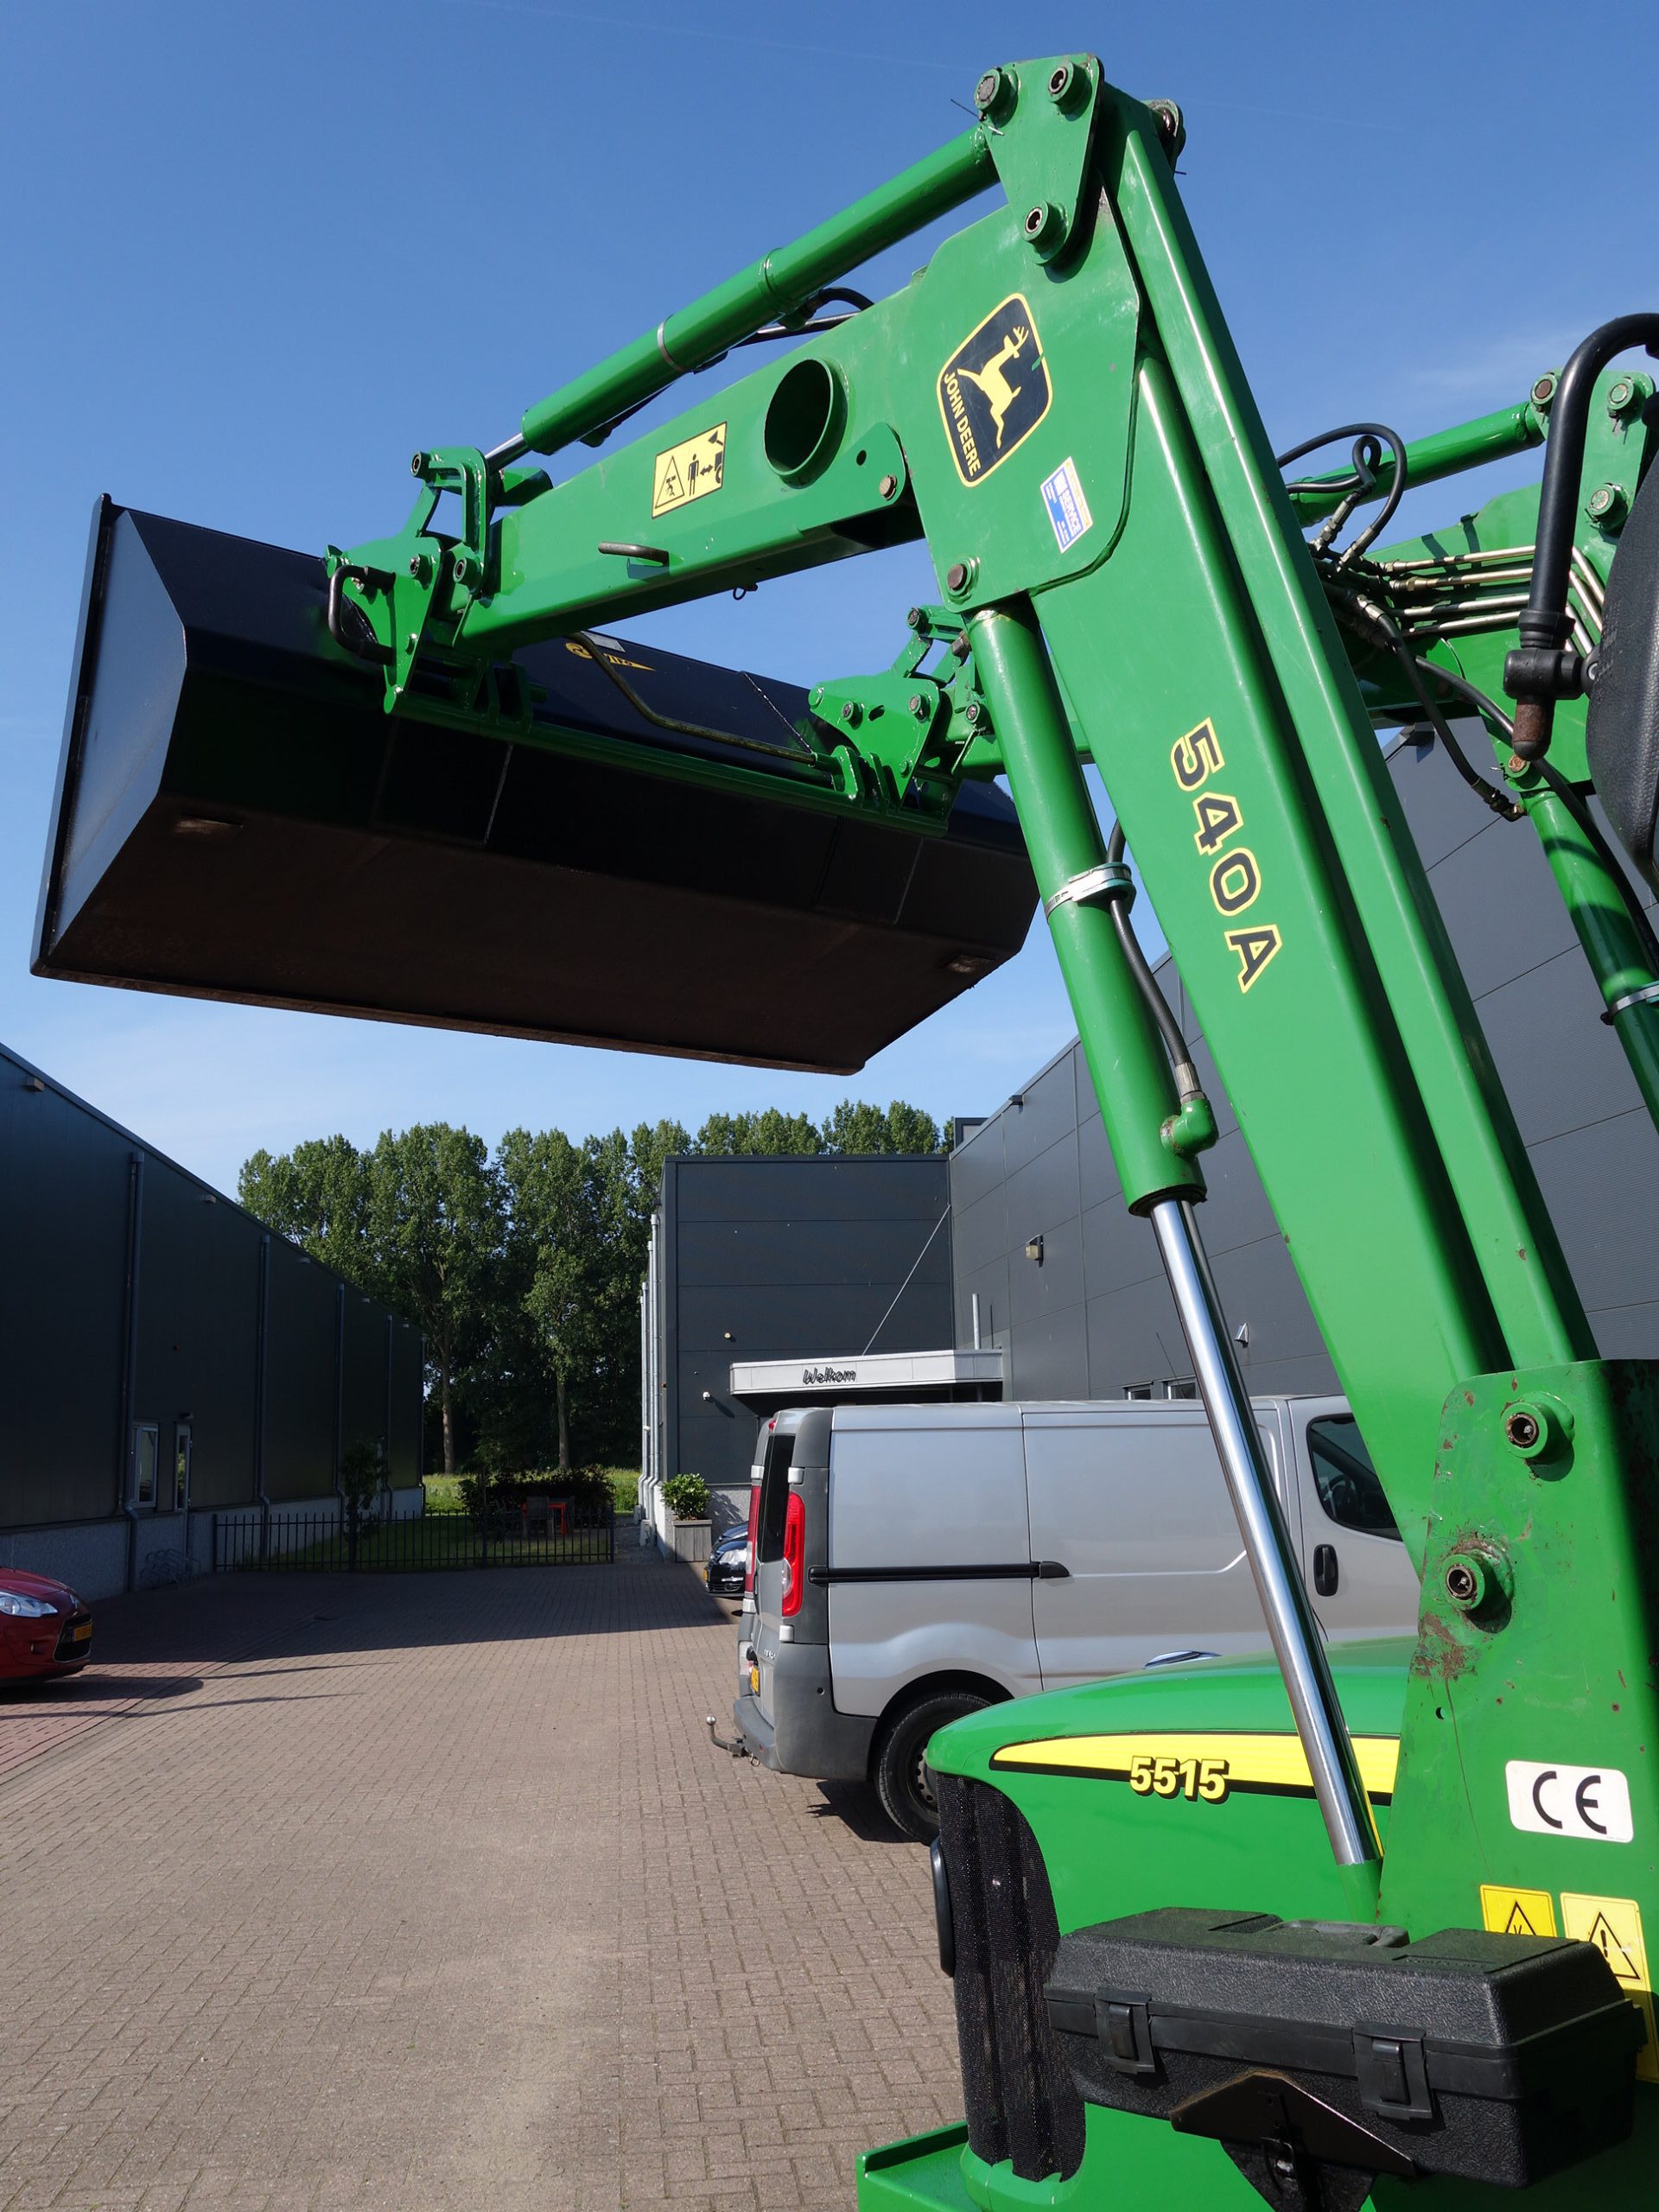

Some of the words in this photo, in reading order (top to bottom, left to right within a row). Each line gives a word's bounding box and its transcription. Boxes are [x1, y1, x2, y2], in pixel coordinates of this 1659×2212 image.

[944, 372, 965, 419] JOHN
[957, 415, 982, 476] DEERE
[1170, 716, 1282, 995] 540A
[803, 1366, 856, 1384] Welkom
[1129, 1755, 1230, 1805] 5515
[1532, 1770, 1608, 1835] CE
